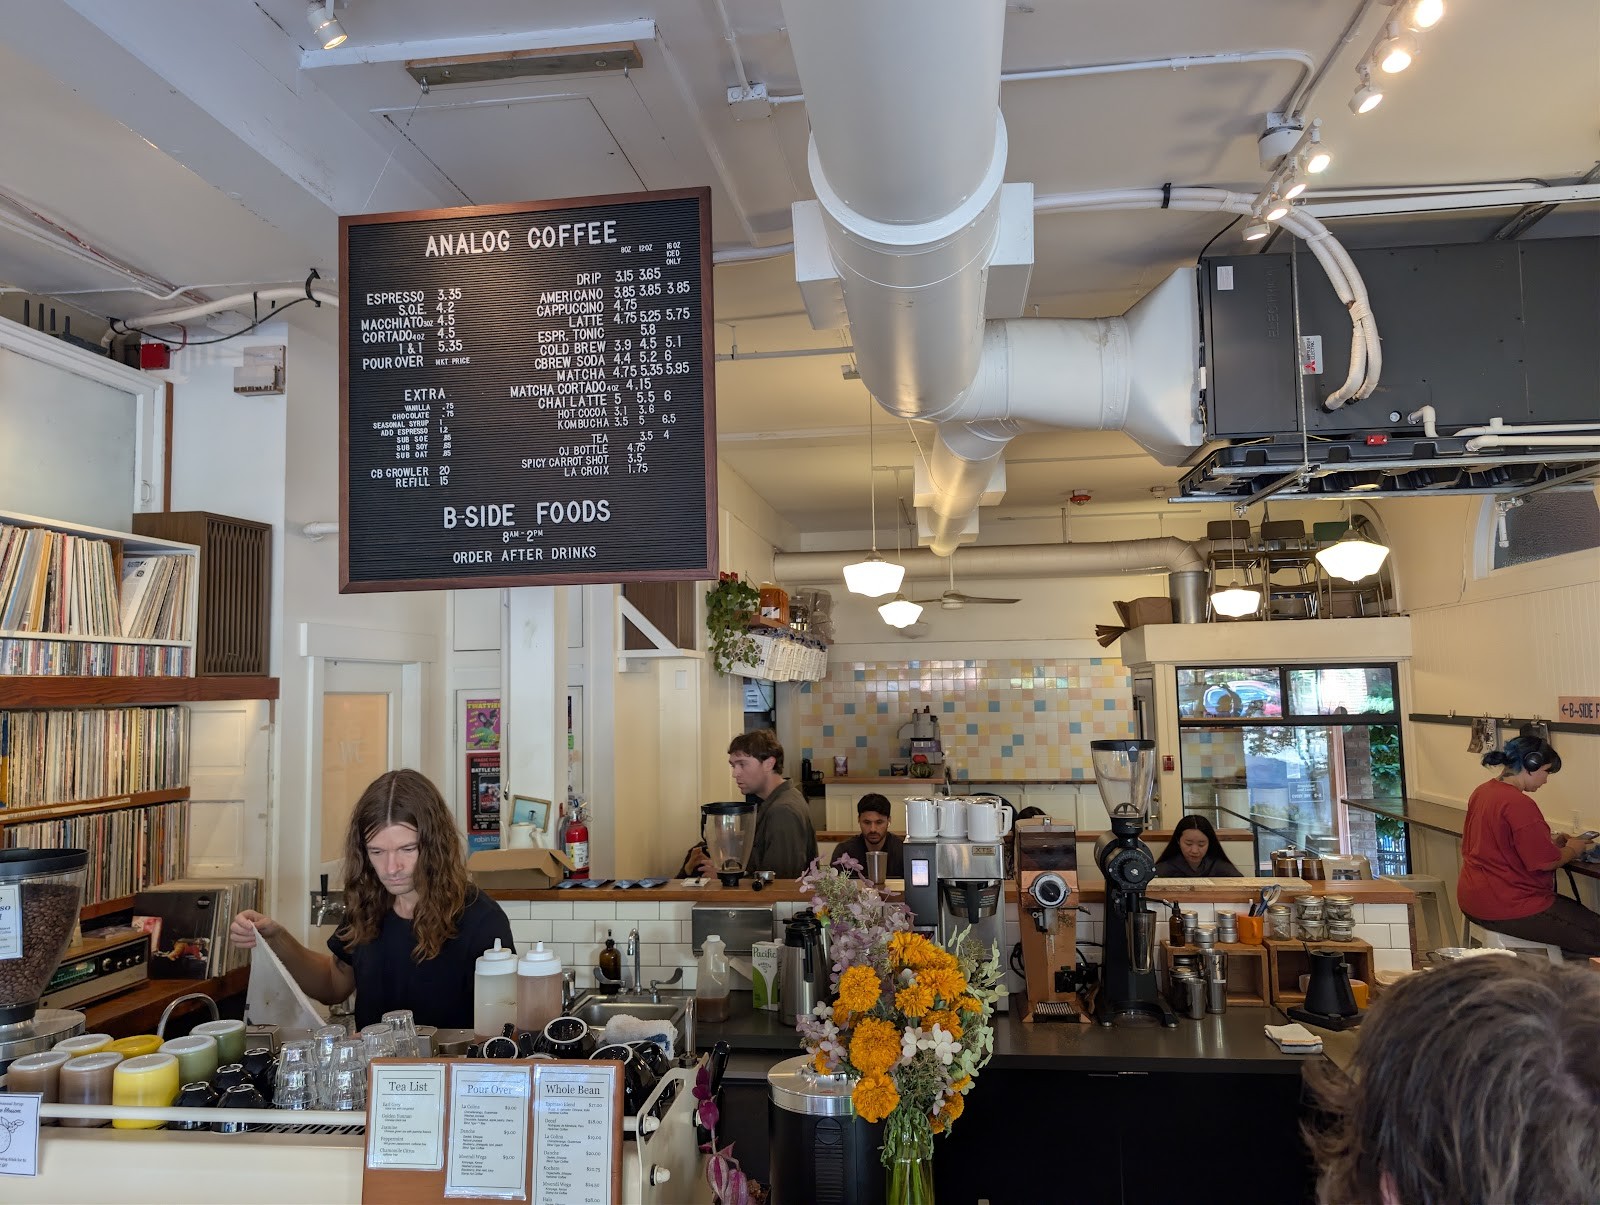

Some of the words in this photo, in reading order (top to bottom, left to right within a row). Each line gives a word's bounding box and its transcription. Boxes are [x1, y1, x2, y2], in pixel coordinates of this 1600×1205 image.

[425, 229, 510, 257] ANALOG
[528, 221, 617, 249] COFFEE
[577, 272, 601, 286] DRIP
[615, 270, 633, 282] 3.15
[639, 267, 661, 281] 3.65
[366, 291, 424, 306] ESPRESSO
[438, 288, 462, 300] 3.35
[540, 288, 604, 304] AMERICANO
[614, 285, 635, 298] 3.85
[639, 283, 661, 296] 3.85
[667, 281, 690, 294] 3.85
[398, 304, 426, 316] S.O.E.
[436, 302, 454, 313] 4.2
[536, 300, 604, 317] CAPPUCCINO
[614, 299, 637, 311] 4.75
[438, 314, 454, 326] 4.5
[569, 314, 604, 328] LATTE
[614, 312, 637, 324] 4.75
[640, 309, 661, 322] 5.25
[666, 308, 690, 320] 5.75
[438, 327, 455, 339] 4.5
[538, 331, 569, 343] ESPR.
[573, 327, 605, 341] TONIC
[640, 324, 656, 336] 5.8
[408, 343, 416, 354] &
[438, 340, 462, 352] 5.35
[540, 343, 569, 356] COLD
[575, 340, 606, 355] BREW
[614, 339, 632, 351] 3.9
[640, 337, 656, 350] 4.5
[666, 335, 681, 348] 5.1
[362, 358, 392, 370] POUR
[395, 356, 424, 368] OVER
[436, 358, 448, 366] MKT
[535, 357, 571, 370] CBREW
[577, 354, 605, 367] SODA
[614, 352, 631, 364] 4.4
[640, 350, 657, 362] 5.2
[665, 350, 672, 362] 6
[557, 368, 605, 381] MATCHA
[613, 365, 637, 378] 4.75
[641, 364, 663, 376] 5.35
[666, 362, 690, 374] 5.95
[404, 388, 446, 401] EXTRA
[510, 384, 554, 398] MATCHA
[626, 378, 651, 391] 4.15
[538, 396, 566, 409] CHAI
[570, 394, 608, 407] LATTE
[615, 393, 621, 405] 5
[637, 390, 655, 404] 5.5
[664, 390, 672, 401] 6
[404, 404, 430, 412] VANILLA
[442, 402, 454, 410] .75
[558, 409, 575, 419] HOT
[578, 407, 607, 418] COCOA
[614, 406, 627, 416] 3.1
[639, 404, 654, 414] 3.6
[392, 412, 430, 420] CHOCOLATE
[442, 410, 454, 418] .75
[558, 418, 609, 430] KOMBUCHA
[614, 416, 628, 427] 3.5
[639, 415, 645, 425] 5
[662, 413, 676, 424] 6.5
[409, 420, 430, 428] SYRUP
[396, 436, 410, 444] SUB
[591, 433, 608, 444] TEA
[640, 431, 653, 441] 3.5
[664, 429, 669, 439] 4
[559, 446, 569, 456] OJ
[574, 444, 608, 456] BOTTLE
[628, 442, 646, 452] 4.75
[522, 458, 546, 468] SPICY
[549, 456, 583, 467] CARROT
[586, 455, 609, 465] SHOT
[628, 453, 642, 463] 3.5
[371, 468, 383, 478] CB
[386, 467, 429, 478] GROWLER
[440, 466, 450, 475] 20
[564, 468, 577, 477] LA
[581, 466, 609, 475] CROIX
[628, 464, 648, 474] 1.75
[396, 477, 430, 488] REFILL
[440, 476, 448, 486] 15
[444, 504, 515, 529] B-SIDE
[537, 500, 611, 525] FOODS
[453, 551, 492, 564] ORDER
[502, 549, 543, 562] AFTER
[552, 546, 596, 560] DRINKS
[753, 947, 777, 958] Pacific
[389, 1081, 406, 1092] Tea
[410, 1081, 428, 1092] List
[467, 1085, 489, 1094] Pour
[491, 1085, 512, 1094] Over
[546, 1084, 575, 1094] Whole
[578, 1085, 600, 1094] Bean
